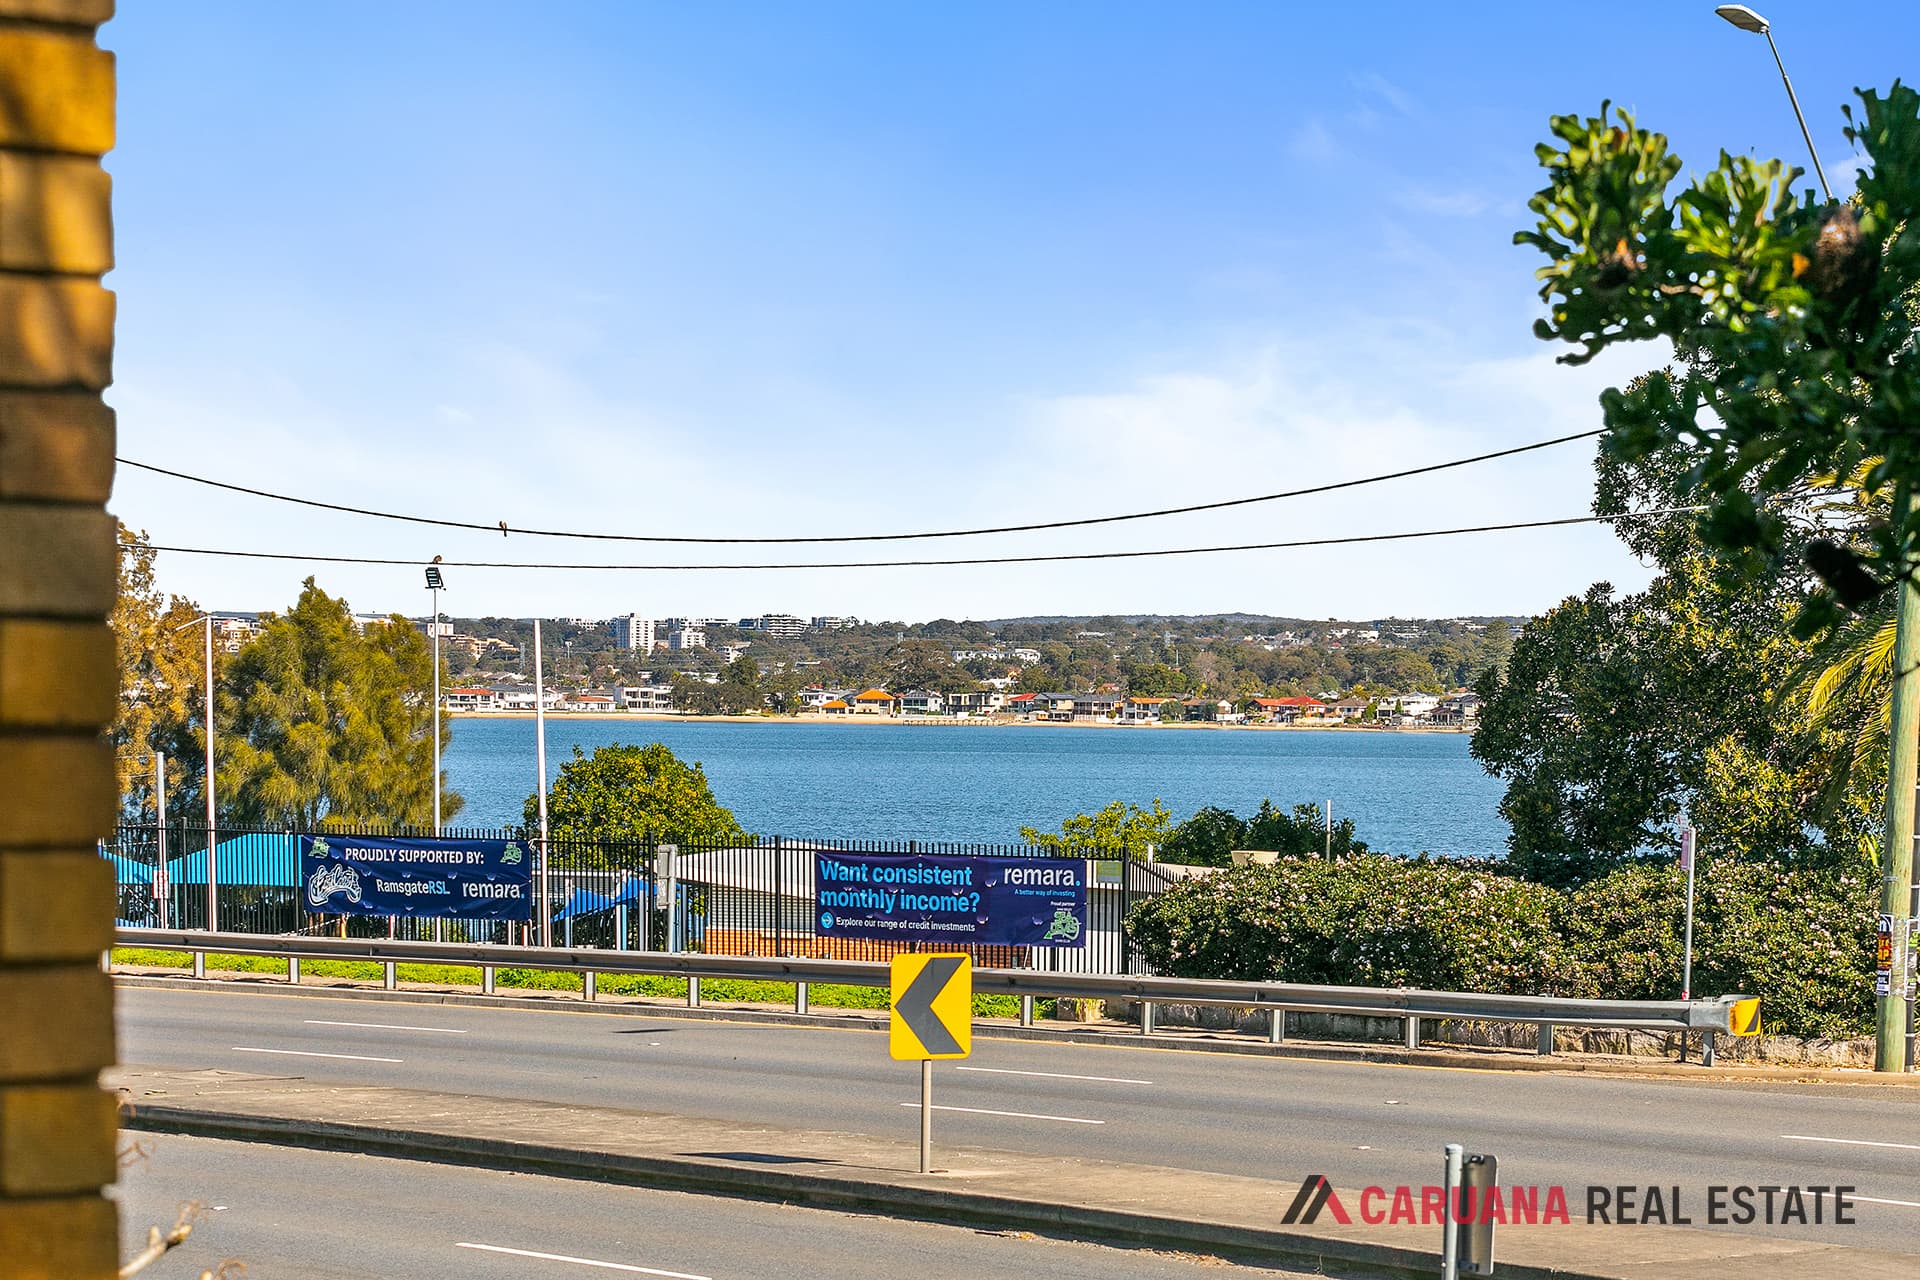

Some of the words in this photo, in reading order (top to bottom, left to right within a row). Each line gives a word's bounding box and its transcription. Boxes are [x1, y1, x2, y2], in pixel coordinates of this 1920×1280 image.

[345, 848, 397, 862] PROUDLY
[399, 849, 463, 864] SUPPORTED
[466, 851, 484, 865] BY:
[819, 860, 868, 882] Want
[872, 863, 972, 886] consistent
[1004, 868, 1080, 887] remara.
[377, 878, 450, 896] RamsgateRSL
[463, 883, 525, 899] remara.
[1053, 890, 1075, 898] investing
[820, 889, 896, 914] monthly
[900, 889, 980, 913] income?
[836, 917, 863, 928] Explore
[864, 918, 876, 927] our
[877, 920, 898, 930] range
[899, 919, 907, 929] of
[908, 920, 930, 930] credit
[931, 921, 976, 932] investments
